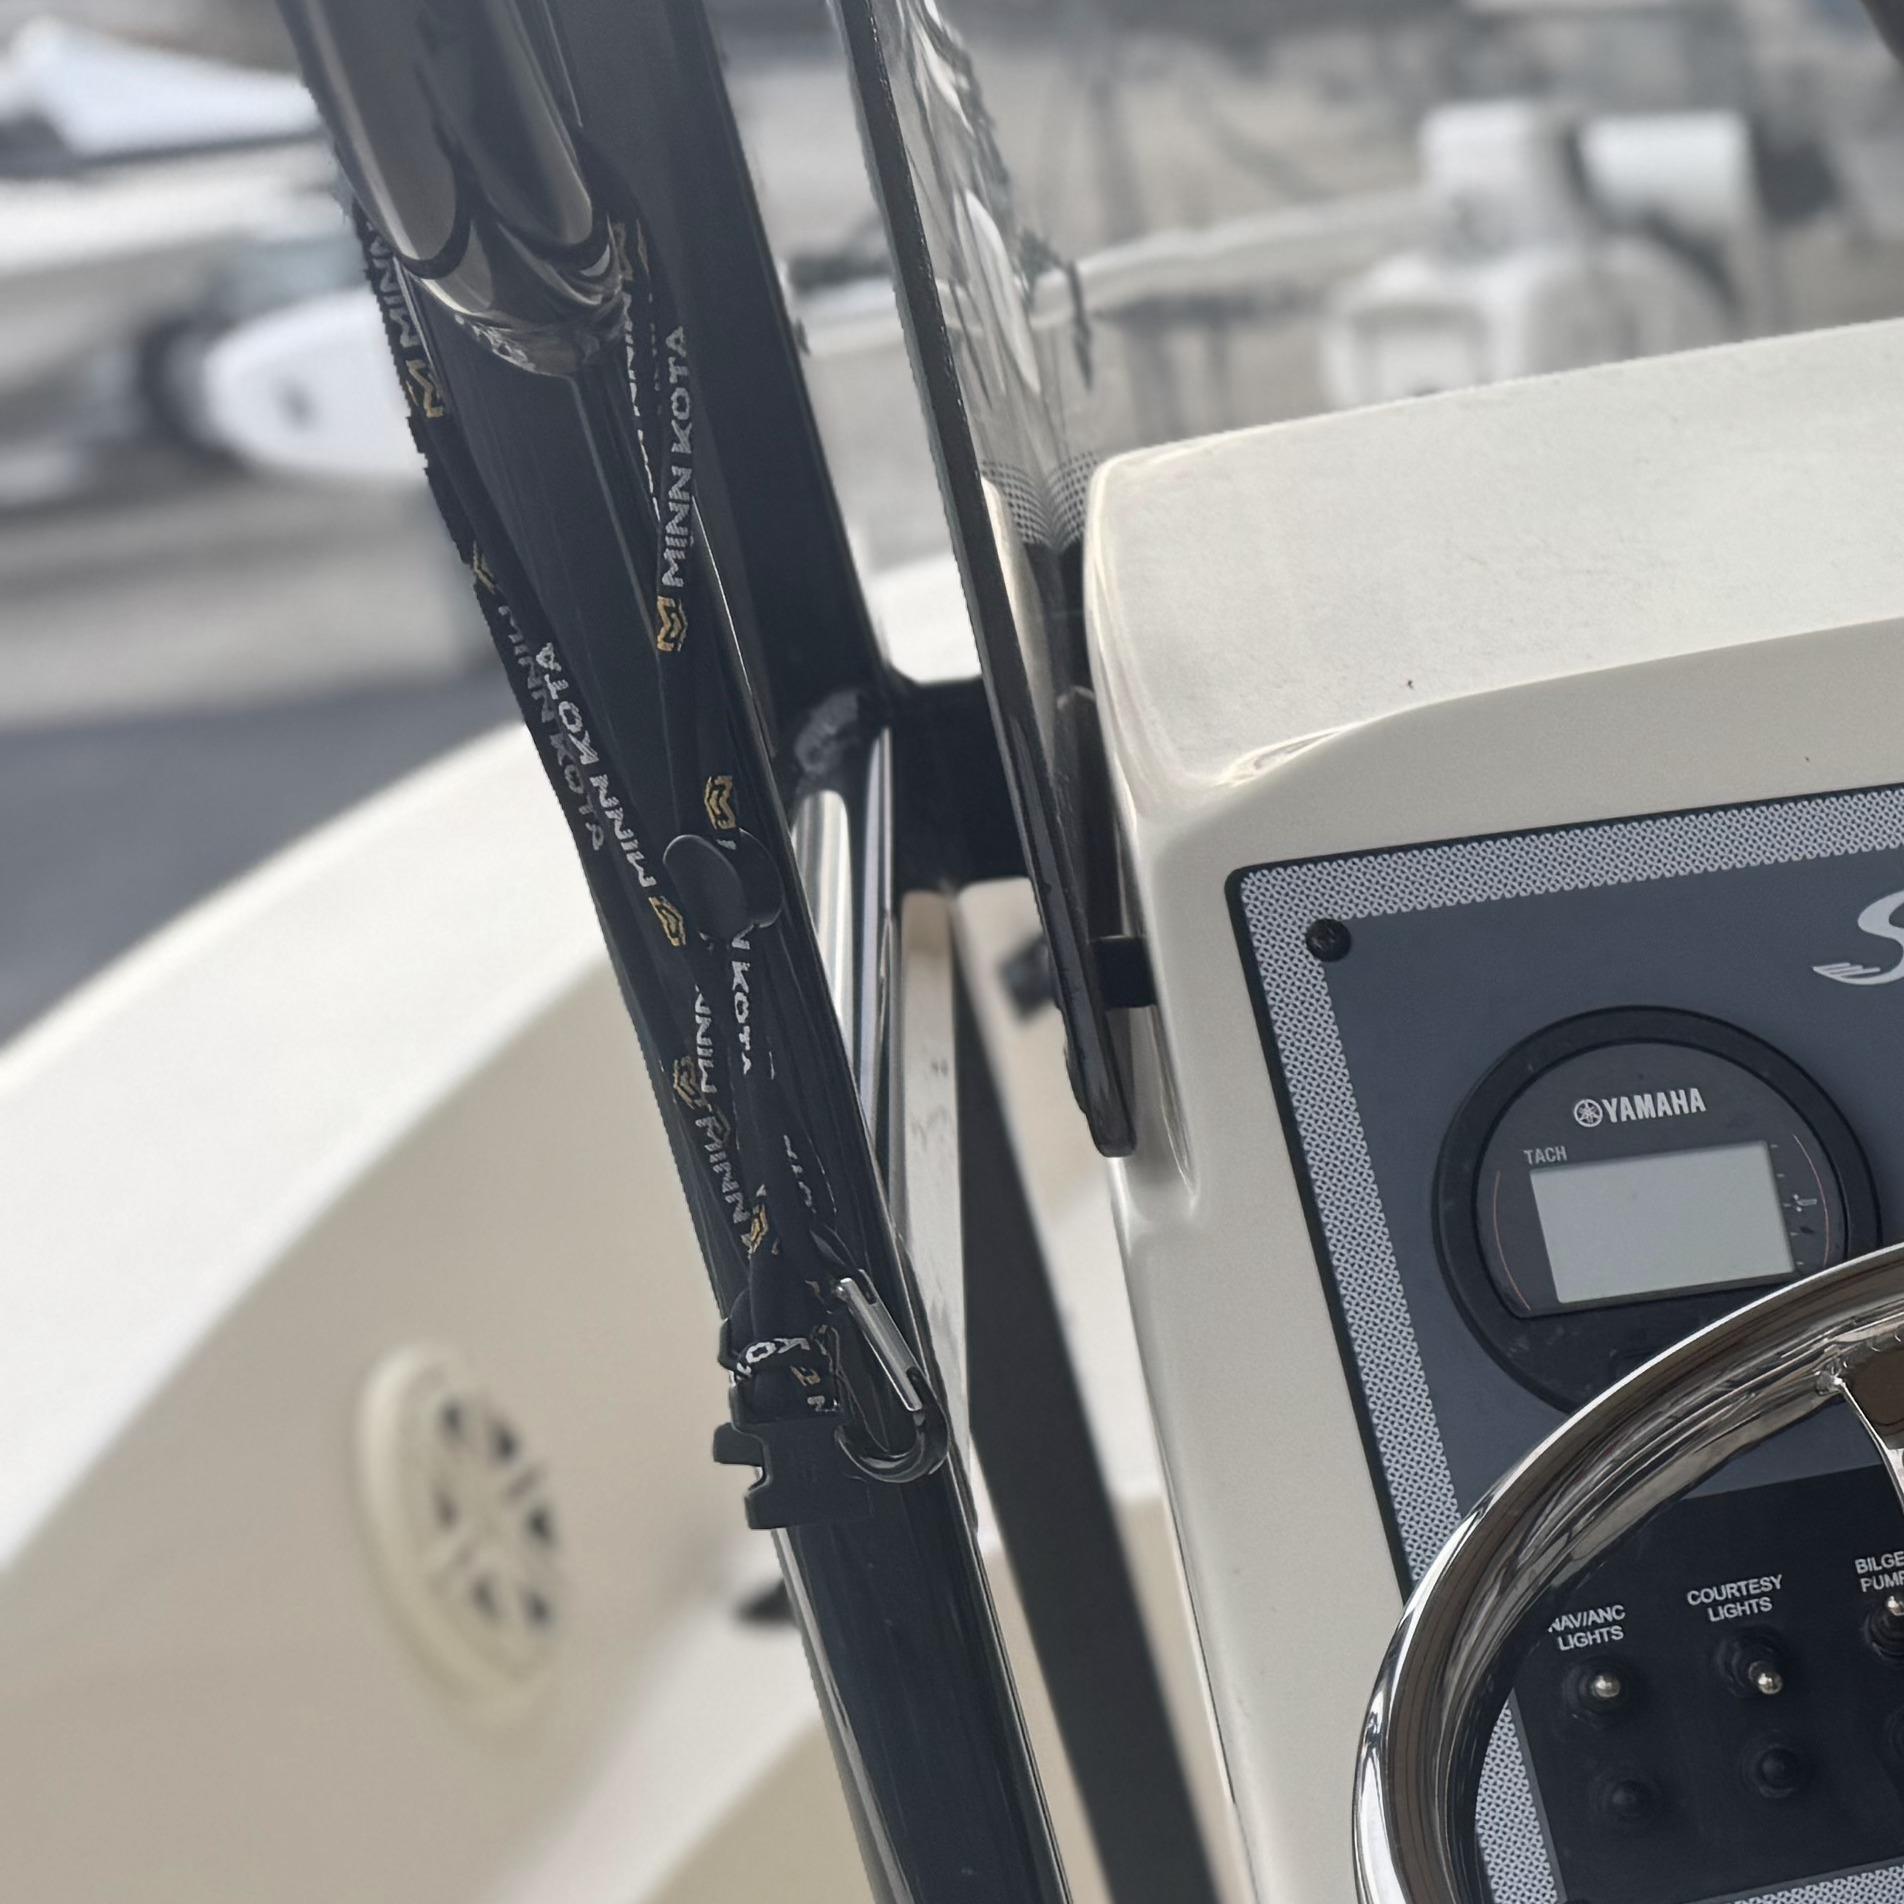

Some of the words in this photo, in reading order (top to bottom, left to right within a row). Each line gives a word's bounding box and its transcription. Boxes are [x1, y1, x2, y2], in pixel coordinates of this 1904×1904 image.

[665, 326, 693, 455] KOTA
[661, 465, 693, 588] MINN
[536, 641, 600, 766] KOTA
[589, 773, 657, 888] MINN
[1601, 1087, 1706, 1123] YAMAHA
[695, 1116, 751, 1224] MINN
[1523, 1145, 1567, 1166] TACH
[1686, 1573, 1784, 1607] COURTESY
[1706, 1595, 1774, 1624] LIGHTS
[1558, 1625, 1624, 1651] LIGHTS
